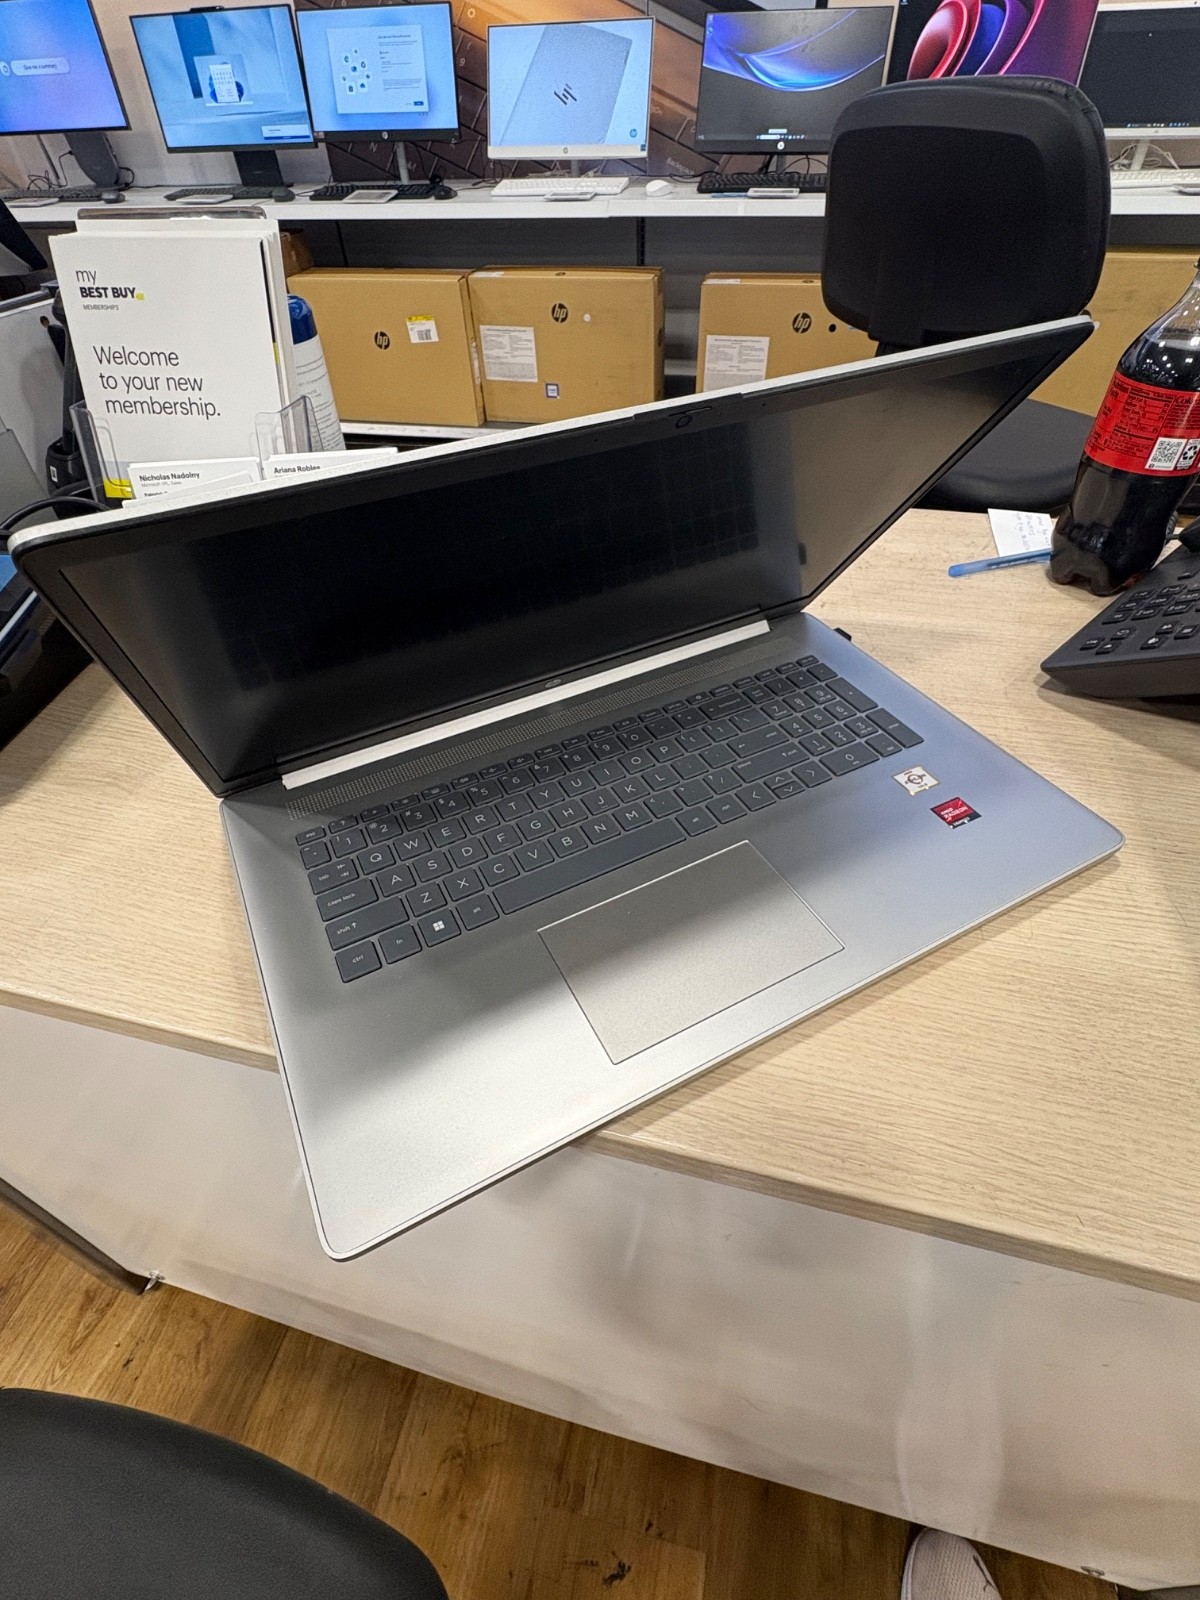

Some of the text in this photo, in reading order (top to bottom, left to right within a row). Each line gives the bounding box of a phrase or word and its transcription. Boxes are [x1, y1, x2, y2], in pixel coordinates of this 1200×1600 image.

[76, 270, 96, 286] my
[80, 286, 136, 298] BEST BUY
[553, 303, 568, 323] hp
[793, 312, 811, 333] hp
[375, 331, 390, 350] hp
[92, 346, 180, 366] Welcome
[99, 372, 203, 394] to your new
[105, 396, 221, 420] membership.
[370, 853, 382, 863] Q
[404, 838, 418, 849] W
[441, 827, 452, 836] E
[474, 814, 486, 824] R
[508, 802, 518, 810] T
[540, 790, 549, 798] Y
[571, 779, 581, 787] U
[660, 746, 668, 754] P
[944, 806, 968, 820] RADEON
[380, 824, 388, 833] 2
[415, 812, 422, 820] 3
[327, 898, 341, 907] caps
[342, 892, 356, 902] lock
[391, 875, 402, 885] A
[427, 860, 438, 870] S
[462, 847, 473, 856] D
[496, 833, 506, 842] F
[530, 820, 541, 829] G
[562, 808, 574, 817] H
[624, 784, 636, 793] K
[337, 926, 351, 935] shift
[420, 892, 432, 903] Z
[457, 878, 469, 888] X
[493, 864, 505, 873] C
[527, 849, 537, 859] V
[561, 836, 572, 846] B
[594, 823, 606, 833] N
[625, 810, 639, 820] M
[352, 955, 364, 963] ctrl
